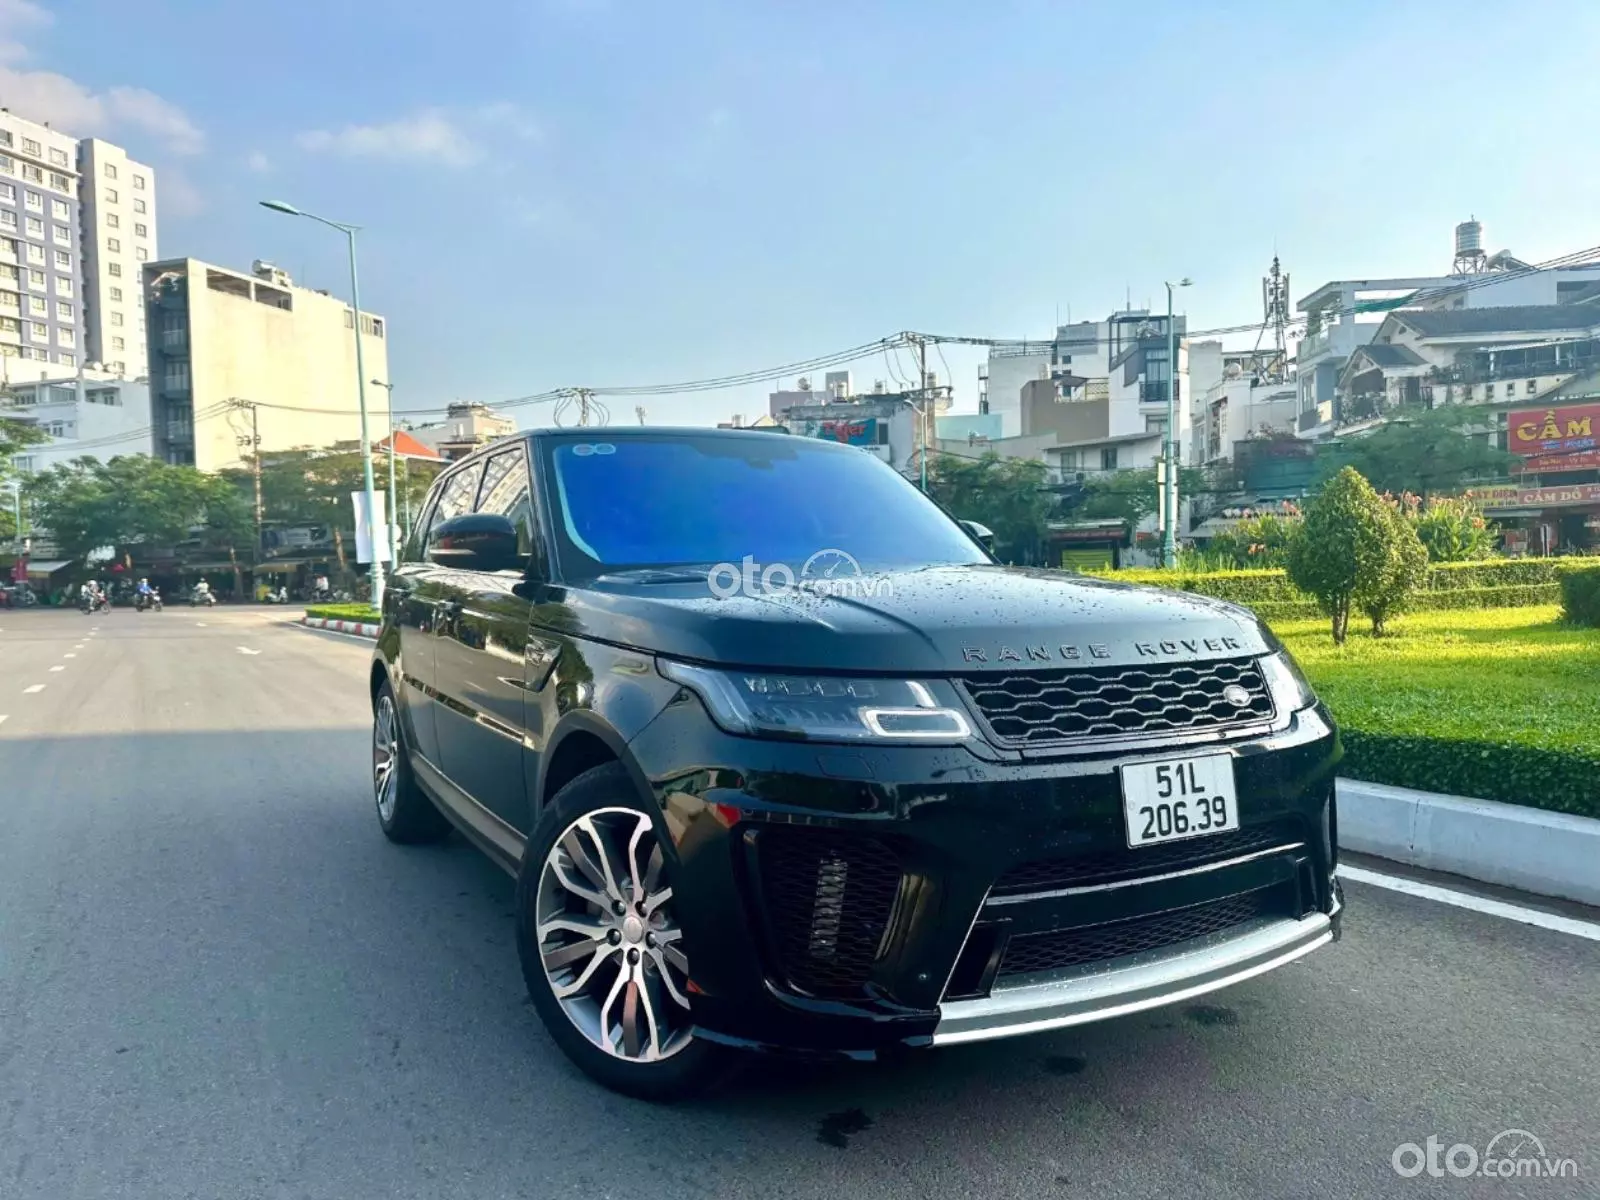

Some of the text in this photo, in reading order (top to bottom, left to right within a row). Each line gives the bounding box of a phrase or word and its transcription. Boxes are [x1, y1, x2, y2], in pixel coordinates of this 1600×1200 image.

[962, 636, 1240, 663] RANGE ROVER
[1155, 762, 1206, 798] 51L
[1139, 795, 1227, 840] 206.39
